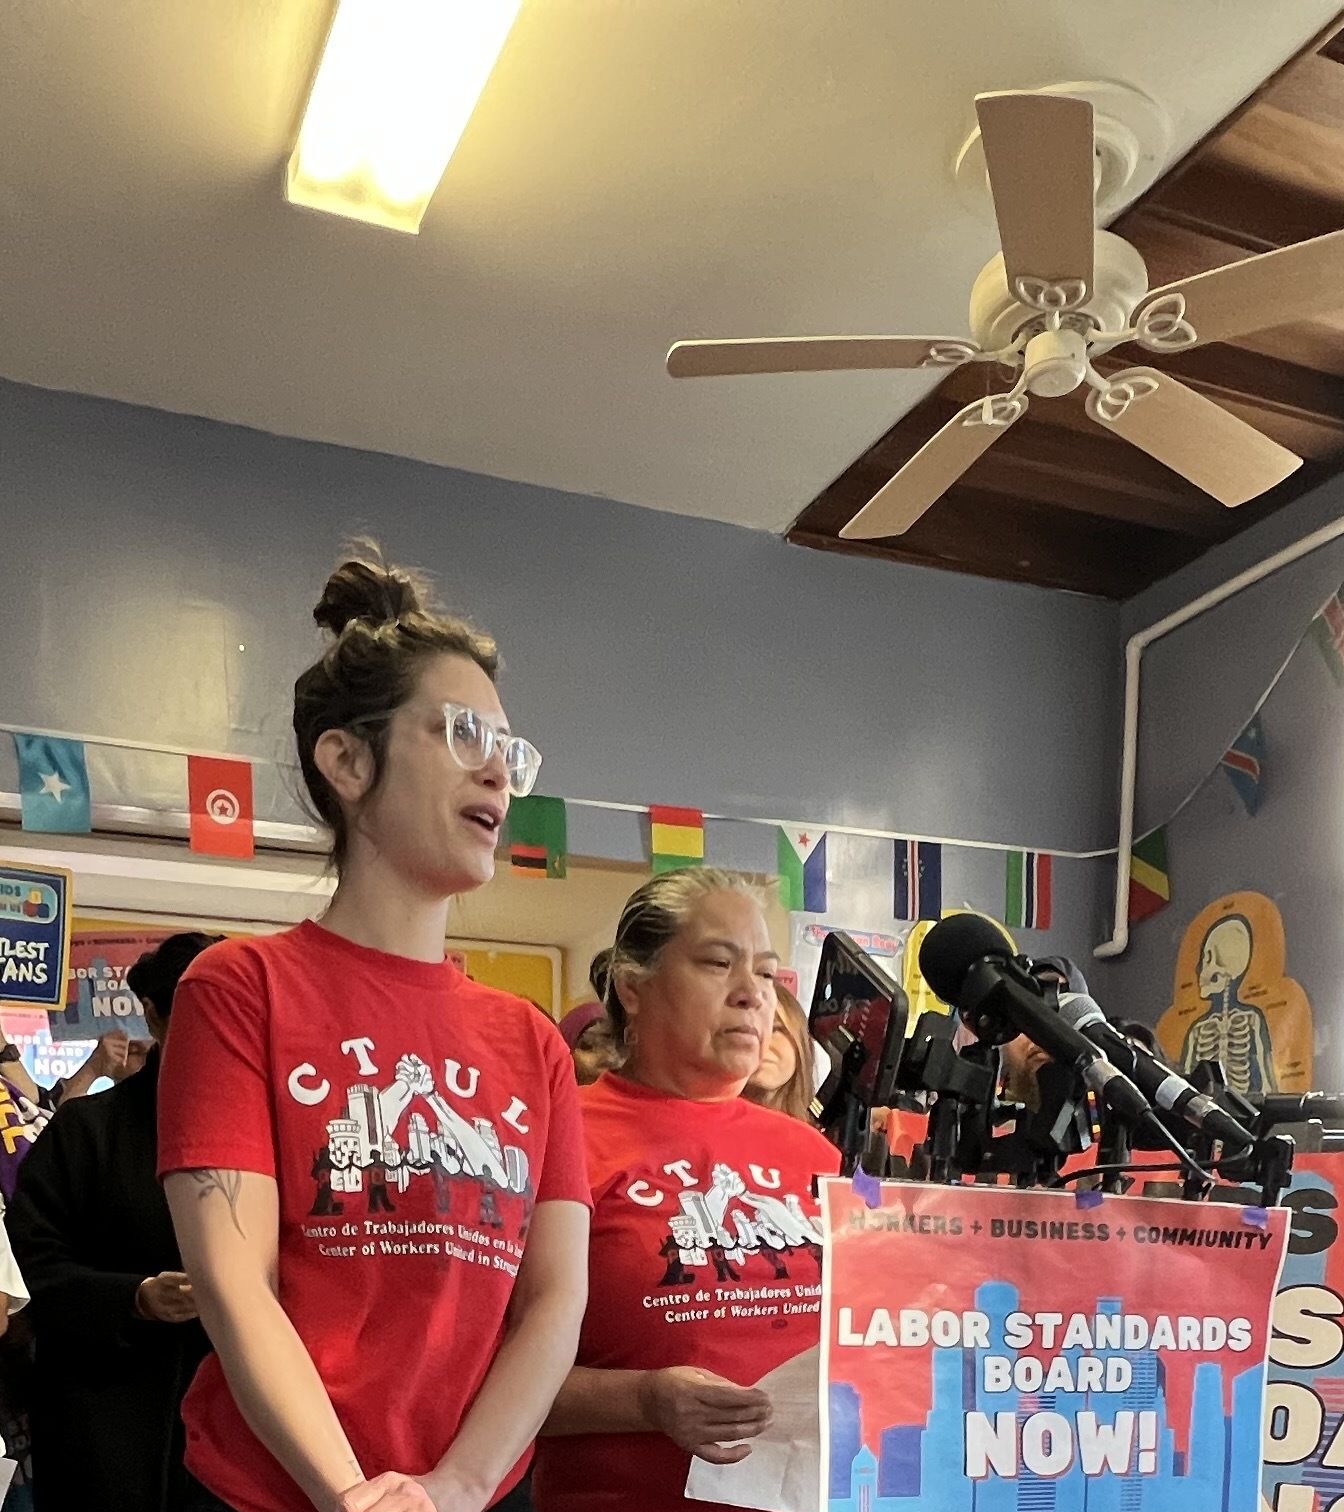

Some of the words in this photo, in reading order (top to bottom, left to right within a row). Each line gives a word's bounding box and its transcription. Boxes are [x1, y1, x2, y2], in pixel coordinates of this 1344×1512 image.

[627, 1159, 821, 1207] CTU
[341, 1220, 359, 1236] de
[363, 1220, 454, 1237] Trabajadores
[493, 1239, 506, 1251] en
[990, 1220, 1110, 1242] BUSINESS
[319, 1243, 357, 1257] Center
[361, 1241, 375, 1256] of
[379, 1240, 440, 1255] Workers
[478, 1250, 490, 1266] in
[642, 1293, 690, 1309] Centro
[695, 1289, 711, 1302] de
[715, 1286, 791, 1302] Trabajadores
[795, 1284, 822, 1297] Unid
[664, 1309, 709, 1324] Center
[713, 1306, 727, 1319] of
[731, 1304, 779, 1318] Workers
[783, 1301, 821, 1315] United
[837, 1307, 992, 1349] LABOR
[1003, 1311, 1253, 1352] STANDARDS
[983, 1355, 1134, 1394] BOARD
[963, 1410, 1159, 1479] NOW!
